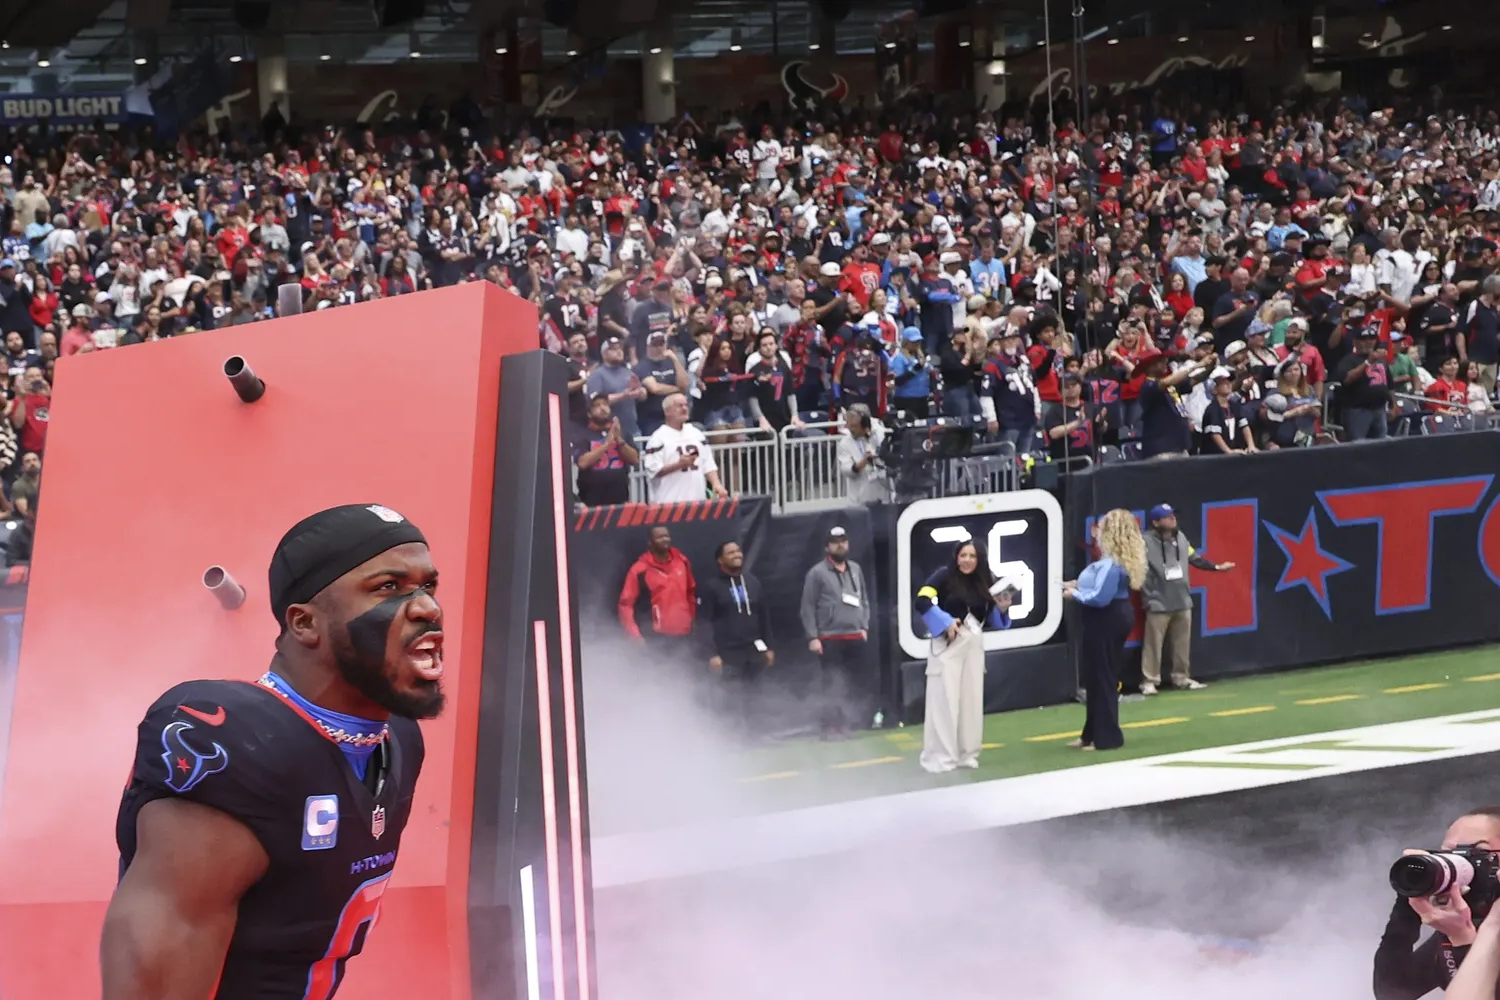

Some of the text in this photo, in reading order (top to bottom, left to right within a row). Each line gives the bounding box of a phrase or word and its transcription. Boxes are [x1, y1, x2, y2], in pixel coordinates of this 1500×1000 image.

[4, 96, 122, 118] BUD LIGHT
[977, 271, 1000, 294] 34
[1091, 378, 1119, 404] 12
[306, 798, 338, 837] C
